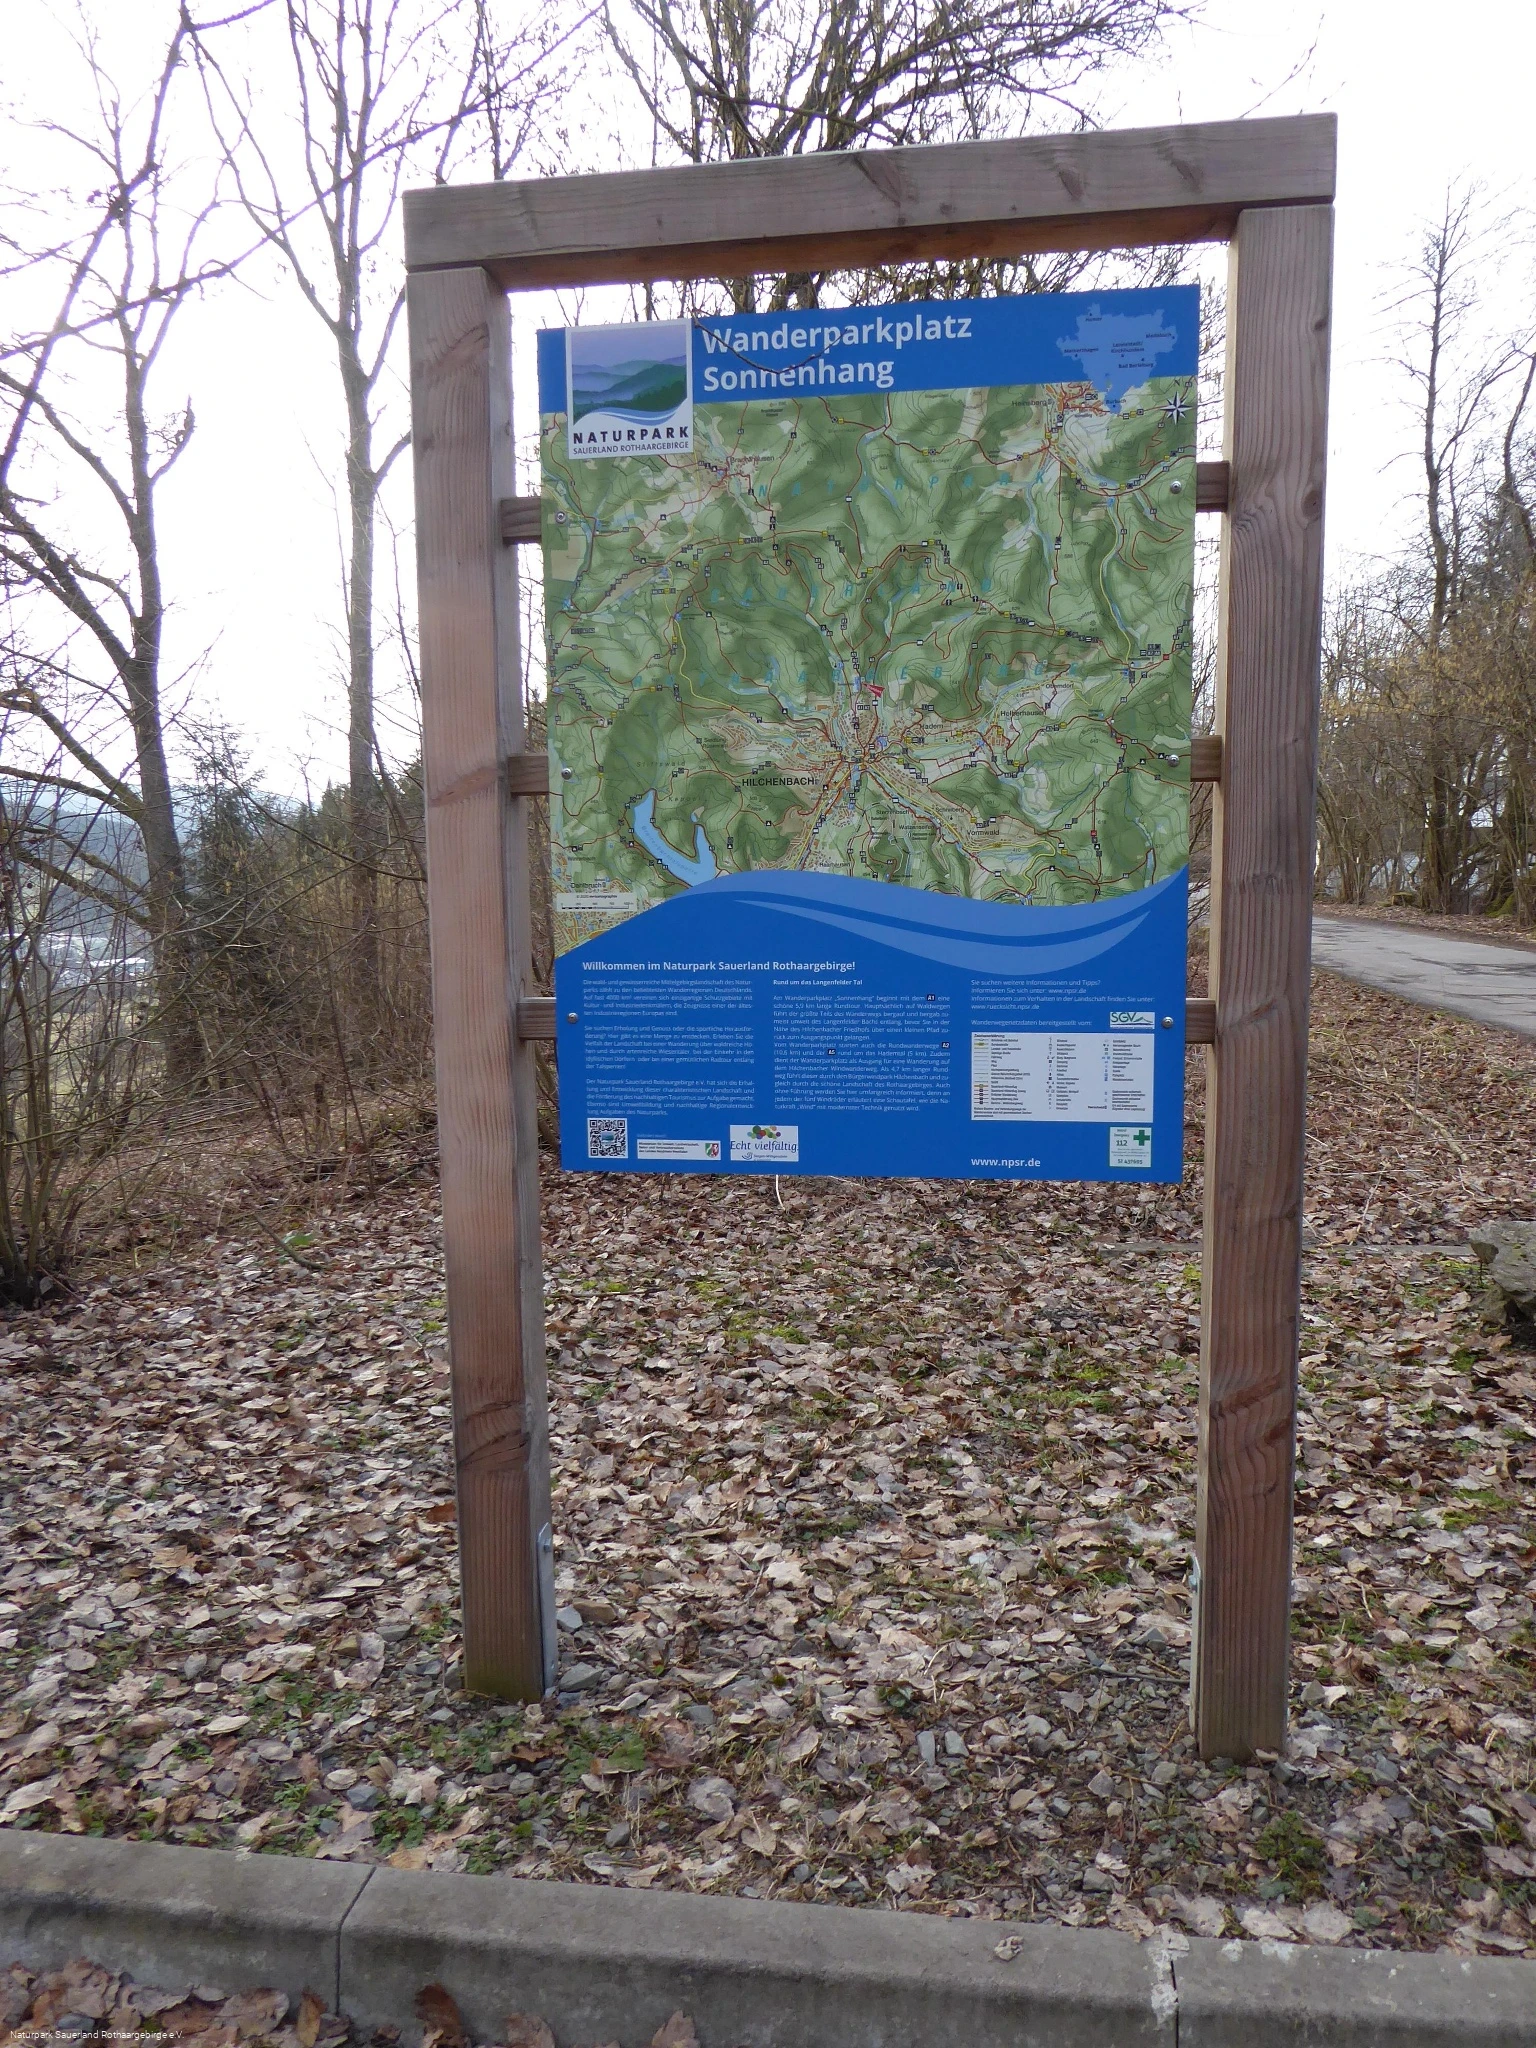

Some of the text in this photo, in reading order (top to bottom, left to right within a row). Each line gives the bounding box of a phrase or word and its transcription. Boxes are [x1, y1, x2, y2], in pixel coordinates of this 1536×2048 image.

[702, 314, 972, 354] Wanderparkplatz
[703, 359, 894, 392] Sonnenhang
[573, 426, 688, 444] NATURPARK
[573, 441, 689, 455] SAUERLAND ROTHAARGEBIRGE
[742, 778, 814, 786] HILCHENBACH
[582, 961, 856, 972] Willkommen im Naturpark Sauerland Rothaargebirge!
[1110, 1012, 1136, 1023] SGV
[730, 1141, 750, 1150] Echt
[971, 1158, 1041, 1168] www.npsr.de
